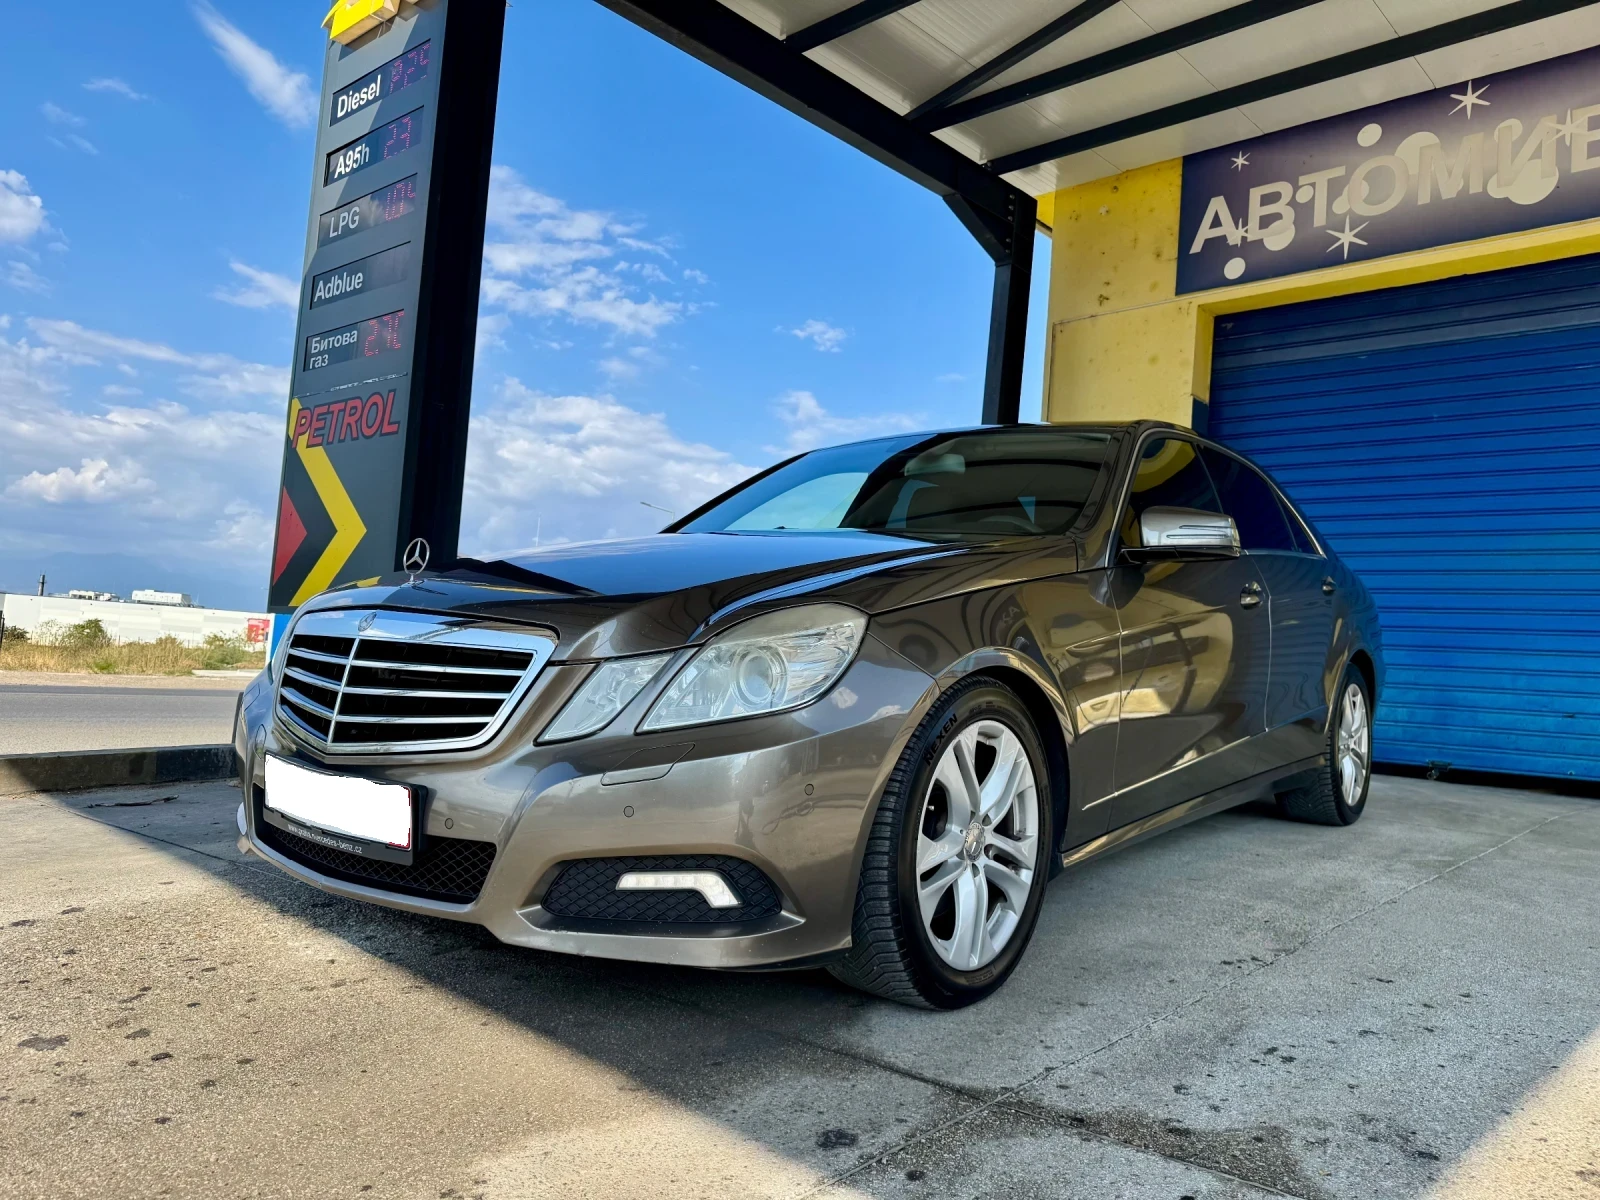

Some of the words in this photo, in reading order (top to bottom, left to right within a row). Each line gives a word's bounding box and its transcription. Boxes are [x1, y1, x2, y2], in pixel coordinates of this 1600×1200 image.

[337, 74, 381, 118] Diesel
[334, 143, 370, 178] A95h
[330, 206, 360, 238] LPG
[314, 272, 363, 302] Adblue
[311, 330, 358, 353] Битова
[309, 354, 329, 369] газ
[291, 389, 400, 448] PETROL
[922, 713, 958, 766] NEXEN
